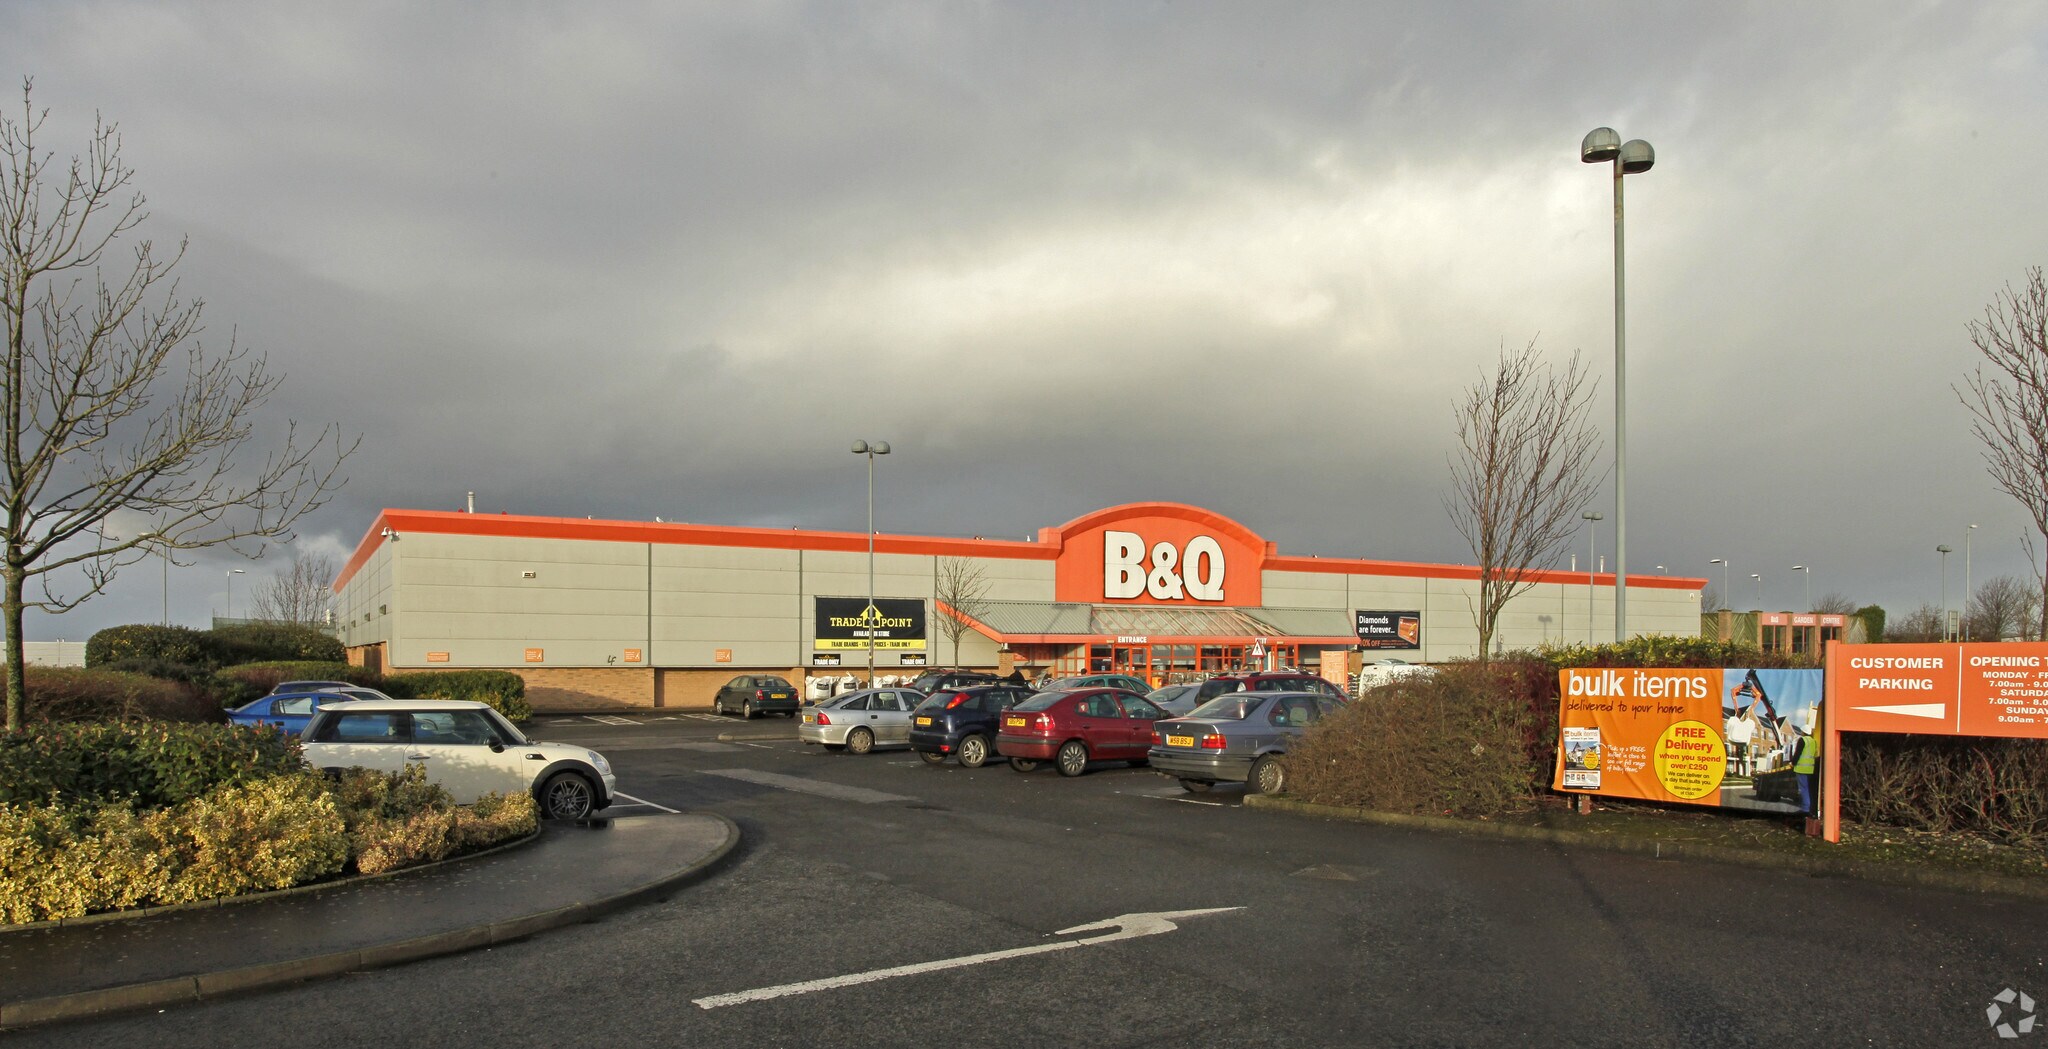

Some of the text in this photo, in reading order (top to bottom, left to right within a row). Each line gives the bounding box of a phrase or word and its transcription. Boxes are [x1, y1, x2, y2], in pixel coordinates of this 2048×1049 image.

[1104, 530, 1226, 601] B&Q
[830, 617, 913, 627] TRADE POINT
[1358, 616, 1388, 624] Diamonds
[1793, 616, 1814, 624] GARDEN
[1850, 657, 1944, 669] CUSTOMER
[1969, 656, 2040, 667] OPENING
[1982, 671, 2029, 679] MONDAY
[1568, 669, 1707, 699] bulk items
[1859, 678, 1934, 690] PARKING
[1989, 680, 2024, 688] 7.00am
[1988, 697, 2024, 705] 7.00am
[1566, 700, 1685, 719] delivered to your home
[2006, 706, 2048, 714] SUNDAY
[1998, 715, 2034, 723] 9.00am
[1675, 727, 1706, 738] FREE
[1665, 739, 1713, 753] Delivery
[1682, 754, 1695, 762] you
[1697, 755, 1721, 763] spend
[1624, 759, 1632, 767] full
[1633, 761, 1646, 769] range
[1688, 763, 1708, 771] £250
